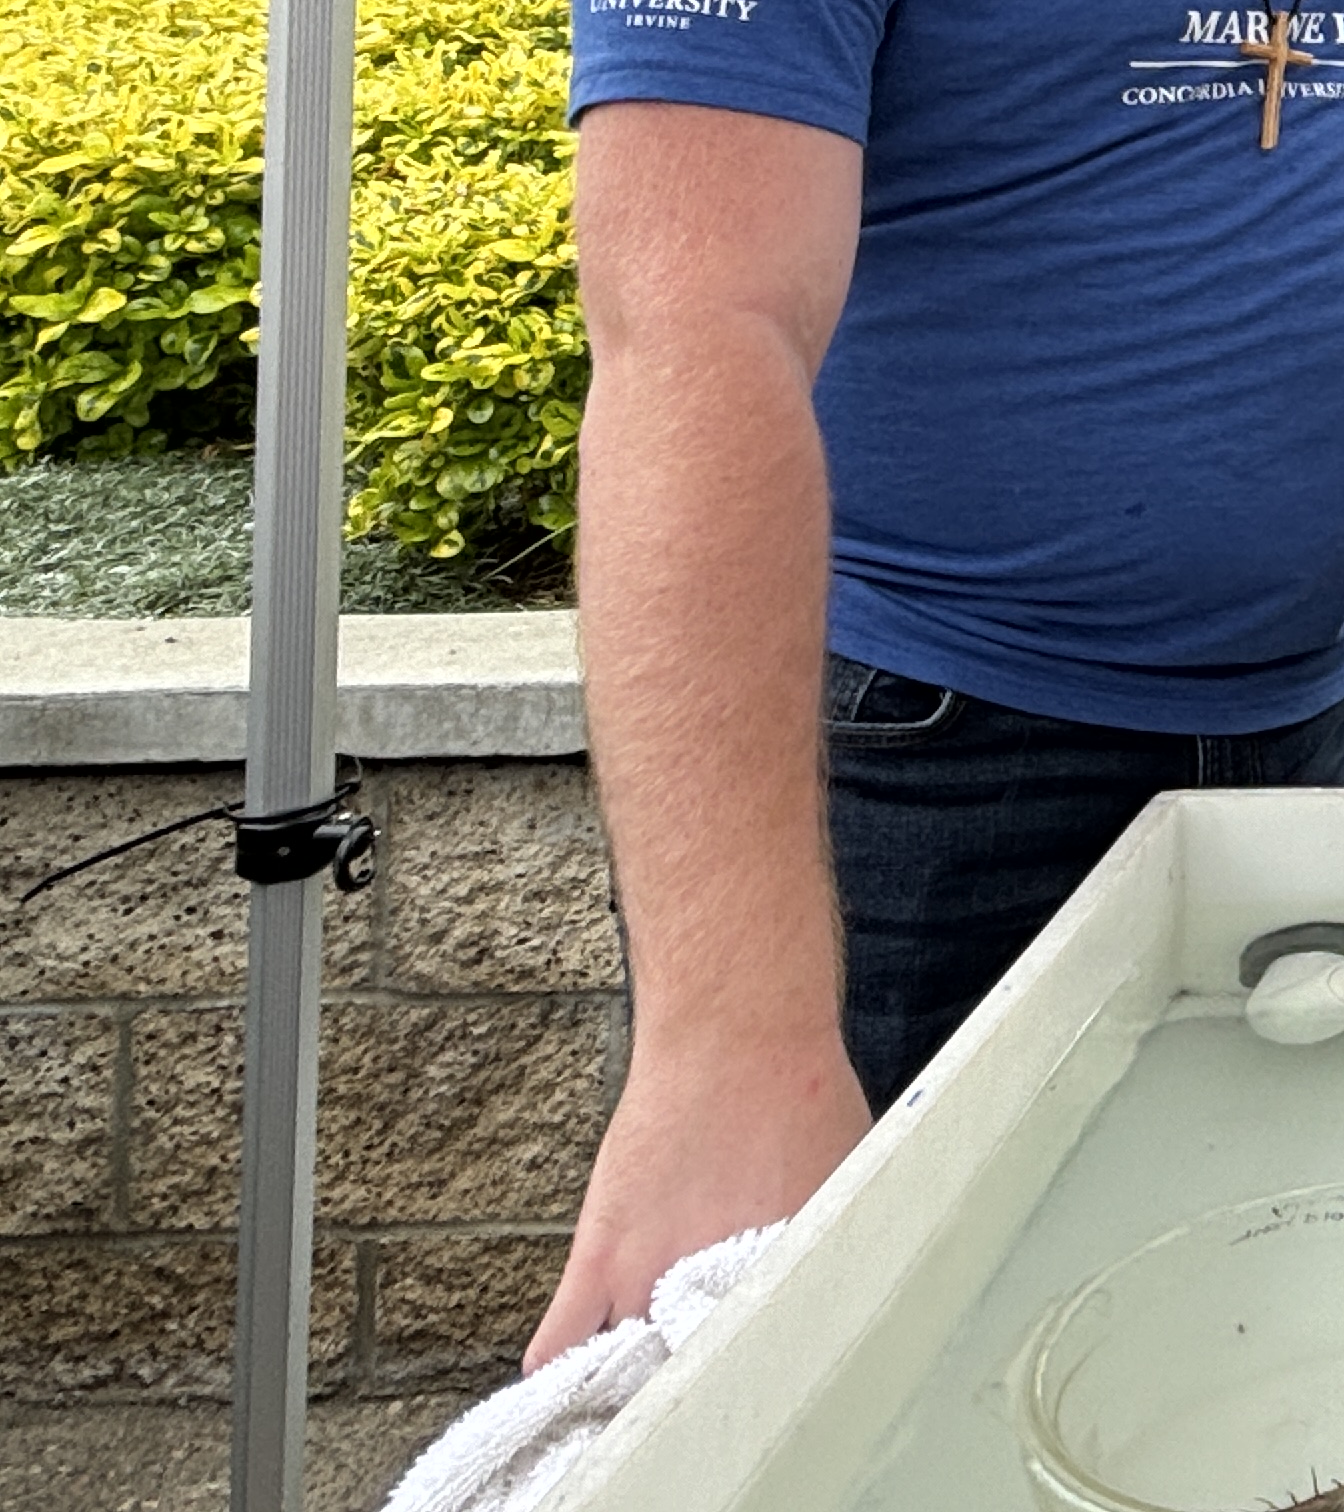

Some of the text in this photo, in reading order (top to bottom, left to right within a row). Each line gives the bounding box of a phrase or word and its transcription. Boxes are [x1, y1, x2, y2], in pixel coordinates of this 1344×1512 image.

[626, 14, 691, 30] IRVINE
[1179, 10, 1325, 45] MARNE
[1121, 80, 1253, 106] CONCORDIA
